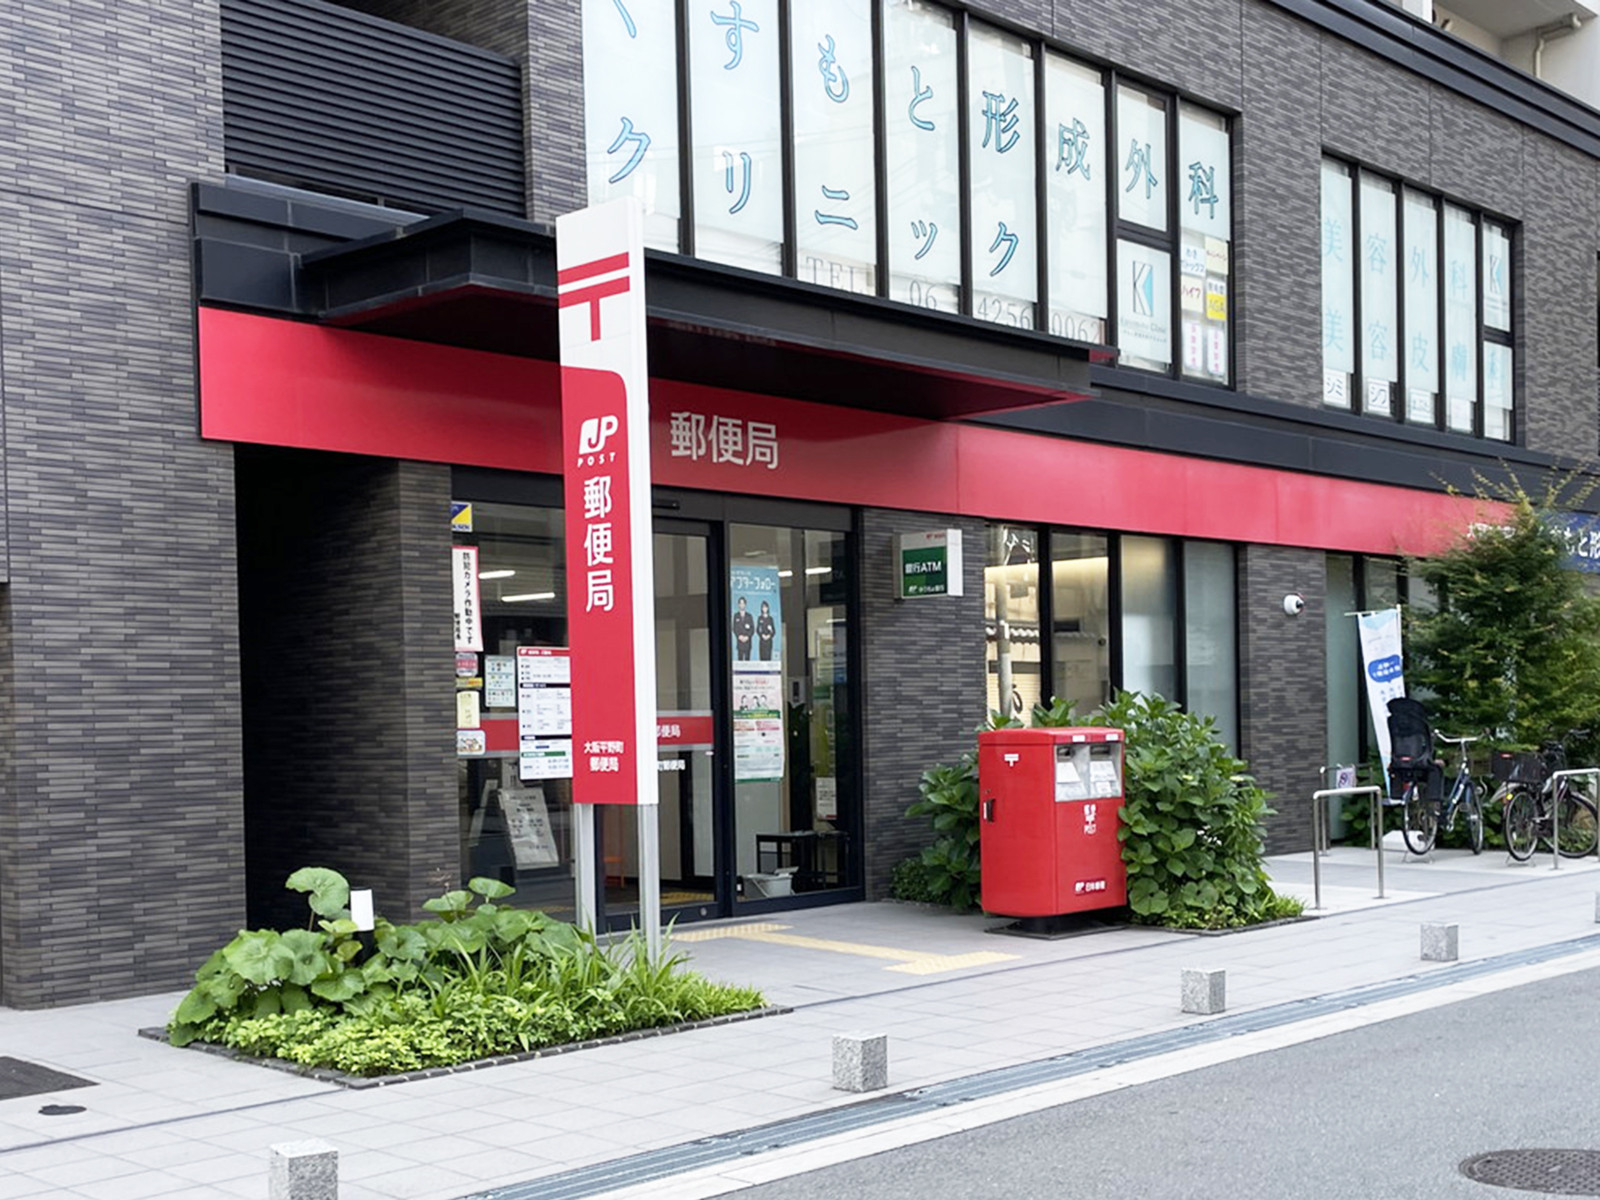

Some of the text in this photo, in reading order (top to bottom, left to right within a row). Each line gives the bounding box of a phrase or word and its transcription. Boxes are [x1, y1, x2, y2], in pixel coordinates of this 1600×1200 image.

[1323, 218, 1468, 299] 美容外科
[909, 279, 937, 309] 06
[577, 452, 616, 468] POST
[670, 411, 779, 469] 郵便局
[583, 475, 614, 613] 郵便局
